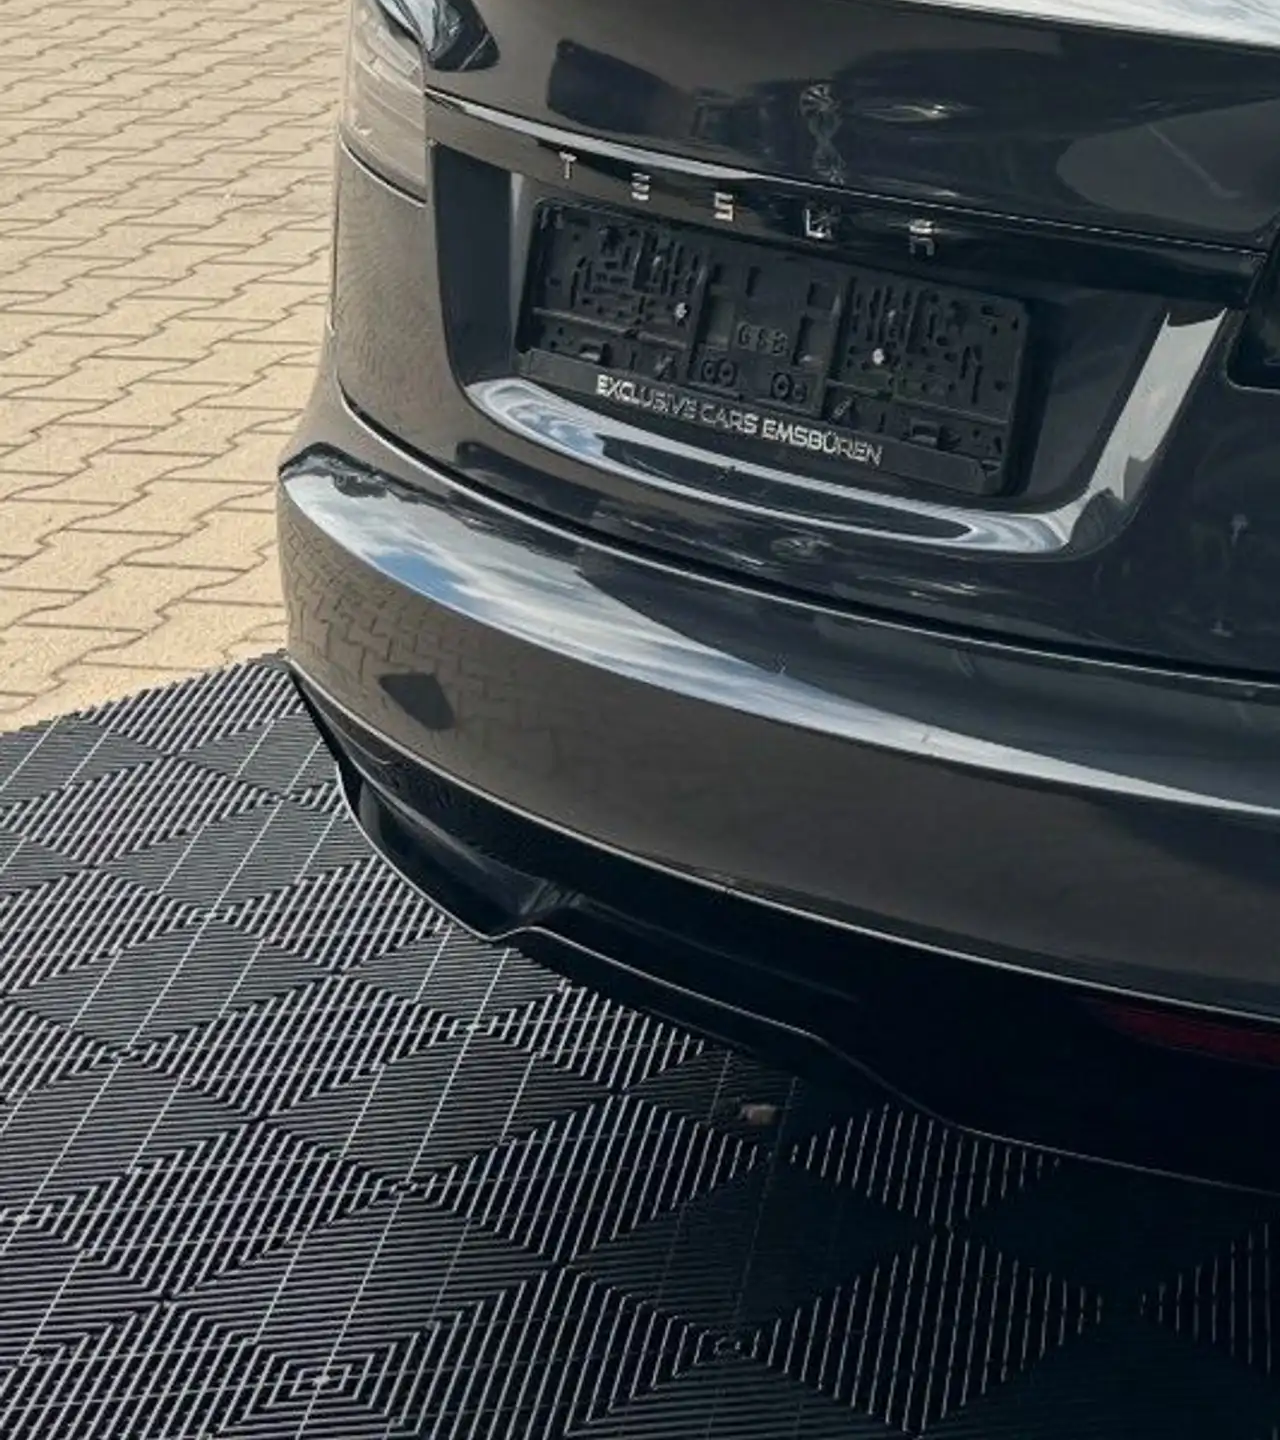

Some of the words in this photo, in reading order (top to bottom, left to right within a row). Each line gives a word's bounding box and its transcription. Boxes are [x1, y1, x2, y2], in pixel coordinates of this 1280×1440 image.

[558, 150, 935, 256] TESLA
[596, 374, 697, 420] EXCLUSIVE
[699, 404, 759, 436] CARS
[761, 417, 883, 467] EMSBÜREN
